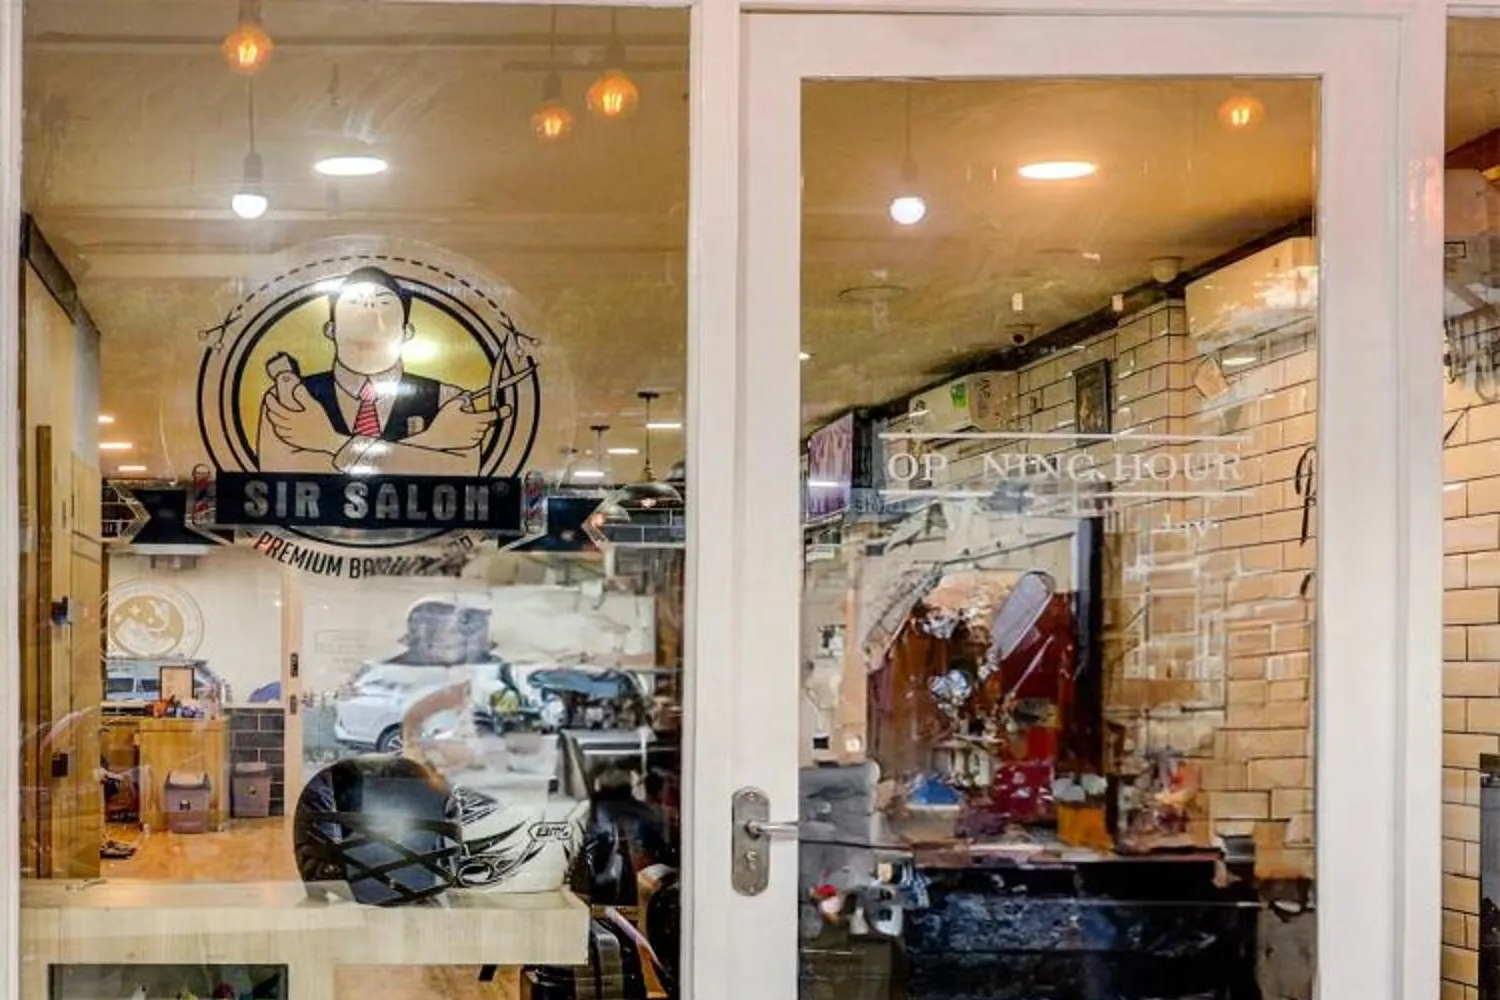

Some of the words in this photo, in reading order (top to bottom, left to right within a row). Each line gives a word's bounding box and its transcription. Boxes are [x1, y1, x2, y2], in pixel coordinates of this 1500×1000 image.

[887, 452, 1106, 481] OPNING
[243, 480, 320, 518] SIR
[343, 481, 489, 521] SALON
[253, 531, 343, 577] PREMIUM
